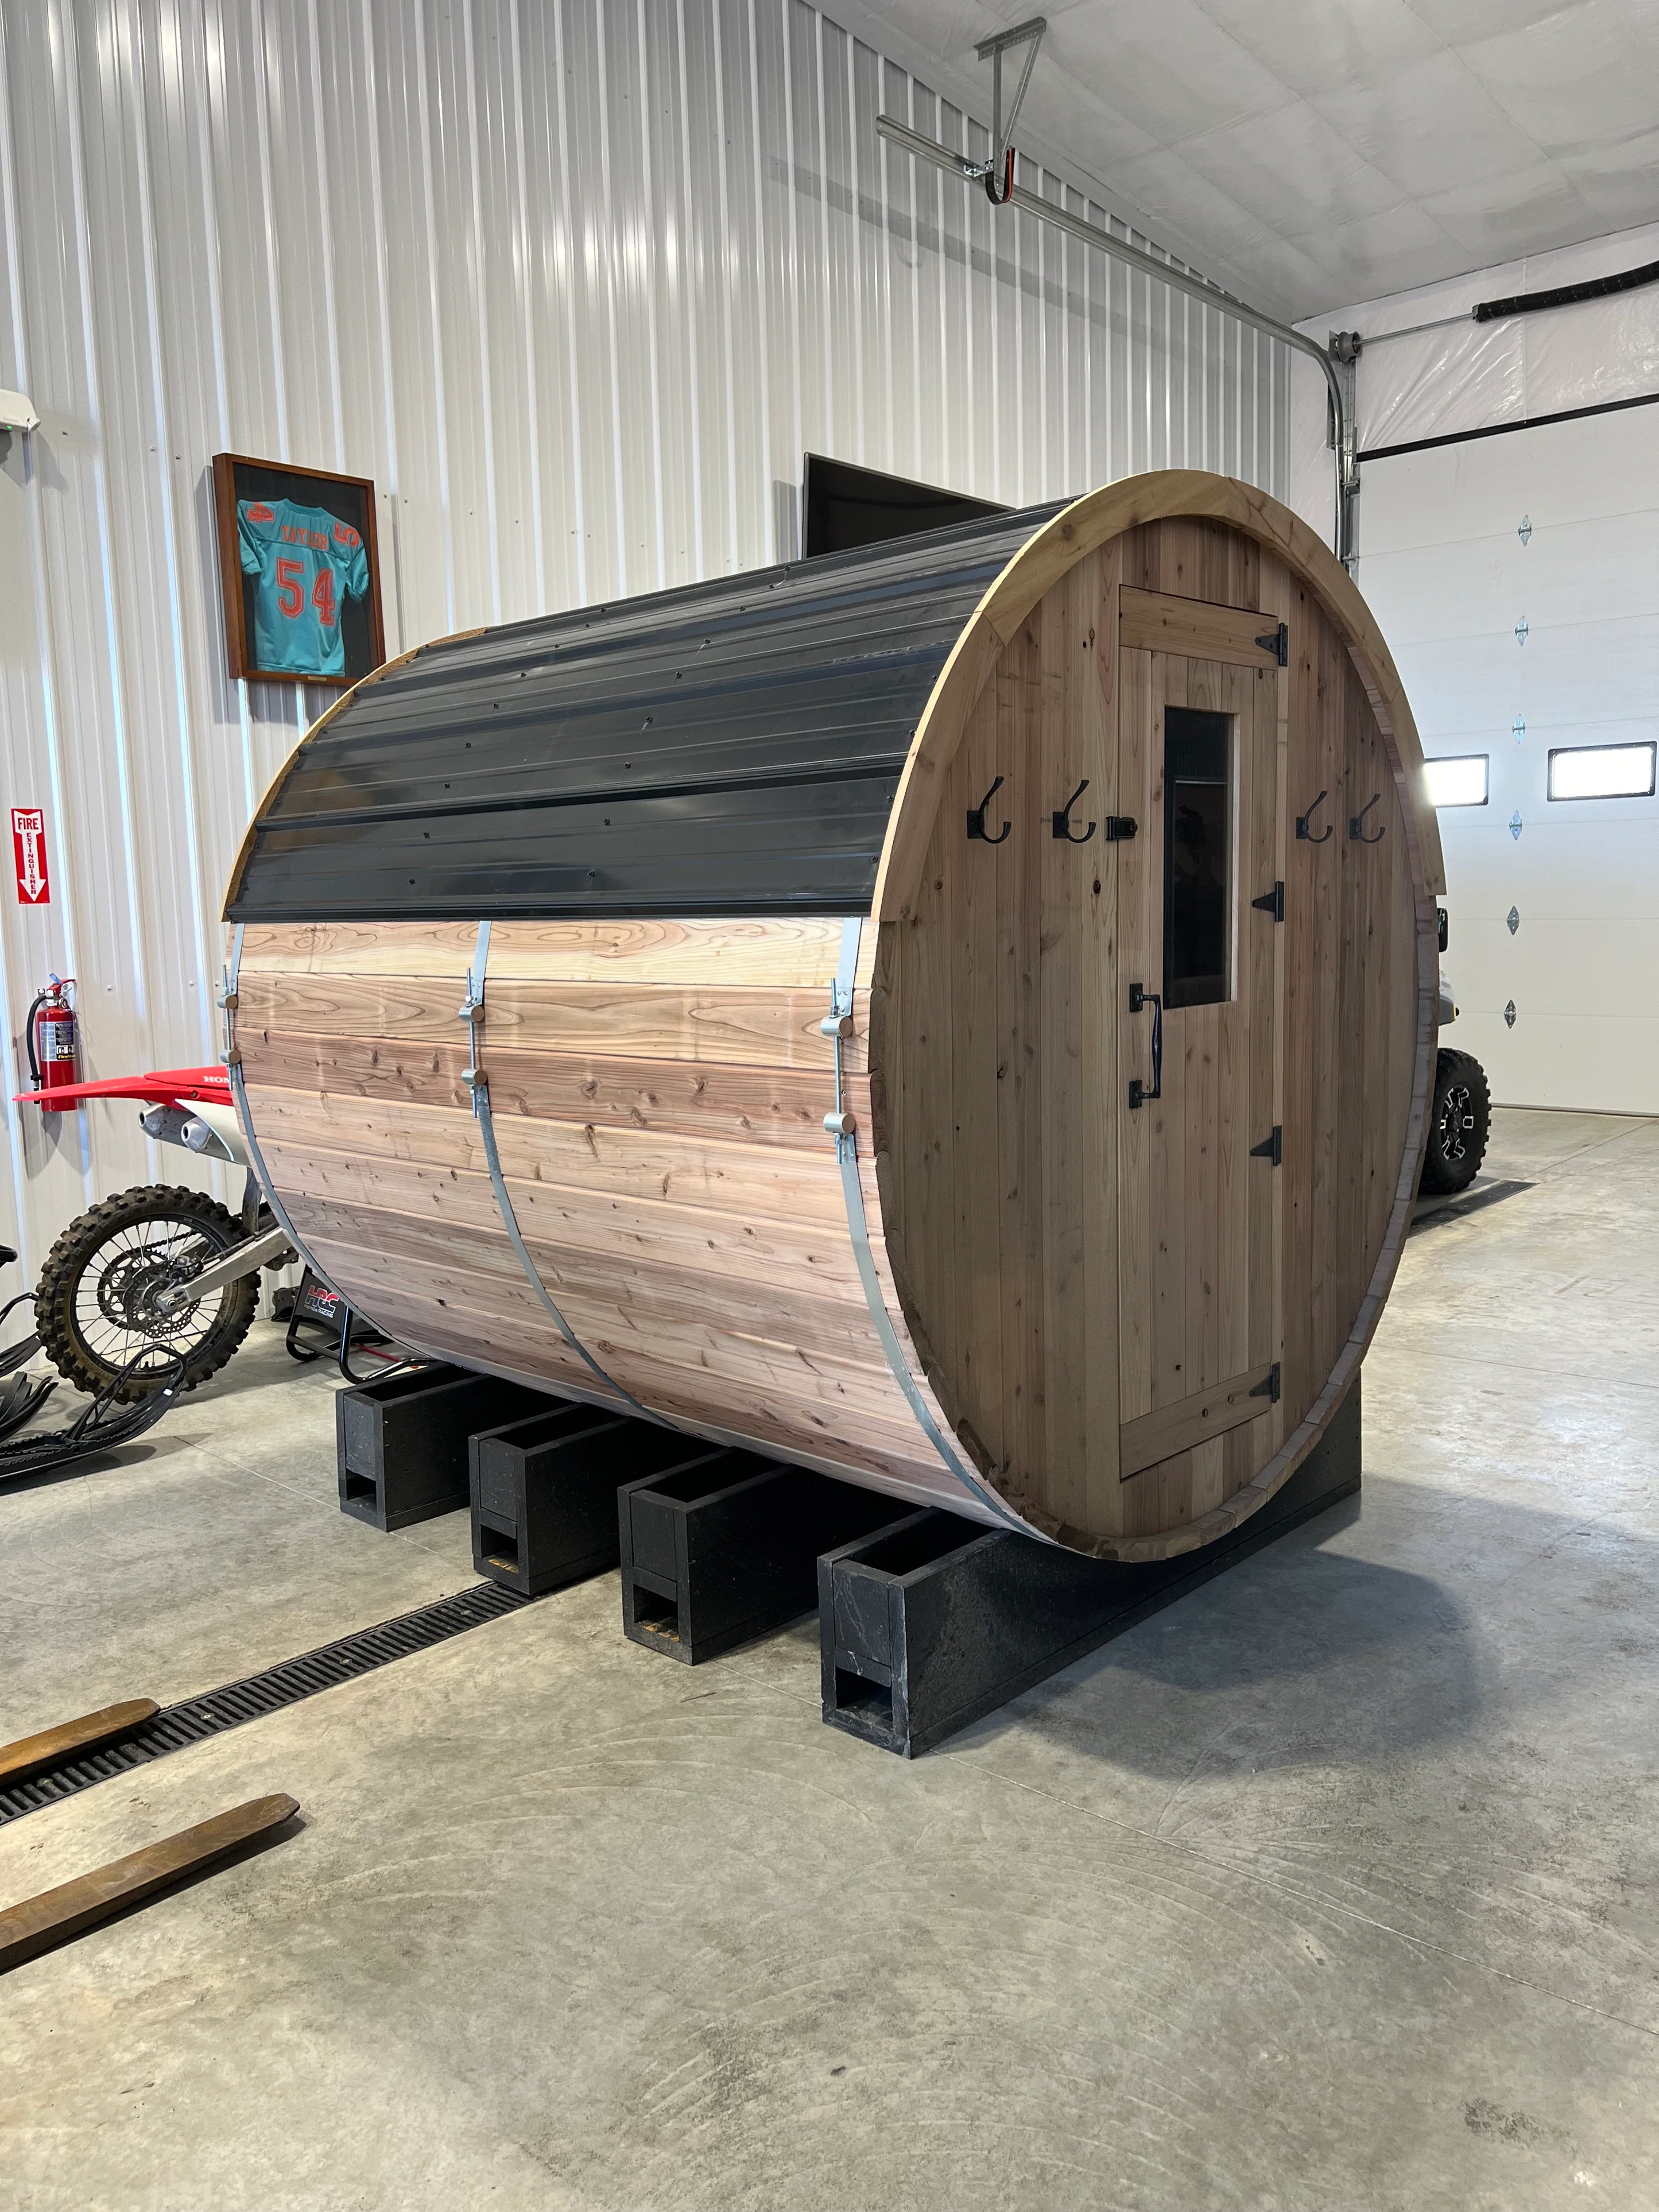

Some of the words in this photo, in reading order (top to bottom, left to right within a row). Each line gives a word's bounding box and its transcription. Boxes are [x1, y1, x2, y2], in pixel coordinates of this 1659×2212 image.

[281, 525, 329, 551] TAYLOR
[276, 557, 335, 626] 54
[18, 818, 39, 830] FIRE
[26, 832, 37, 894] EXTINGUISHER
[203, 1075, 229, 1084] HON
